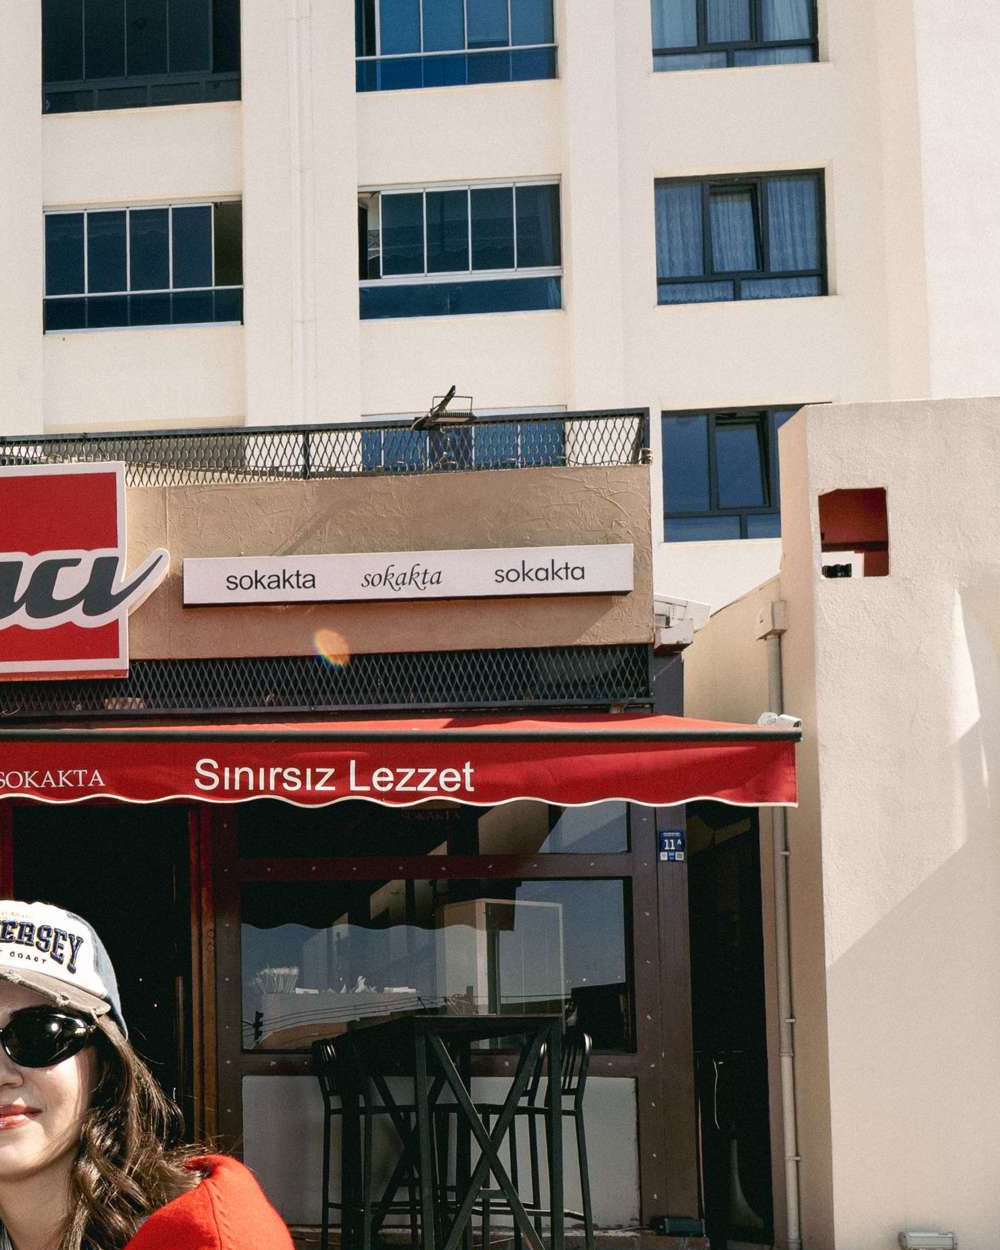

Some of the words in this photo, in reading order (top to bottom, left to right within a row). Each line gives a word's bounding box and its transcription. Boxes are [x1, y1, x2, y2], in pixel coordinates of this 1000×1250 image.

[225, 569, 316, 591] sokakta
[361, 563, 443, 592] sokakta
[494, 559, 585, 584] sokakta
[194, 758, 336, 792] Sınırsız
[349, 759, 475, 792] Lezzet
